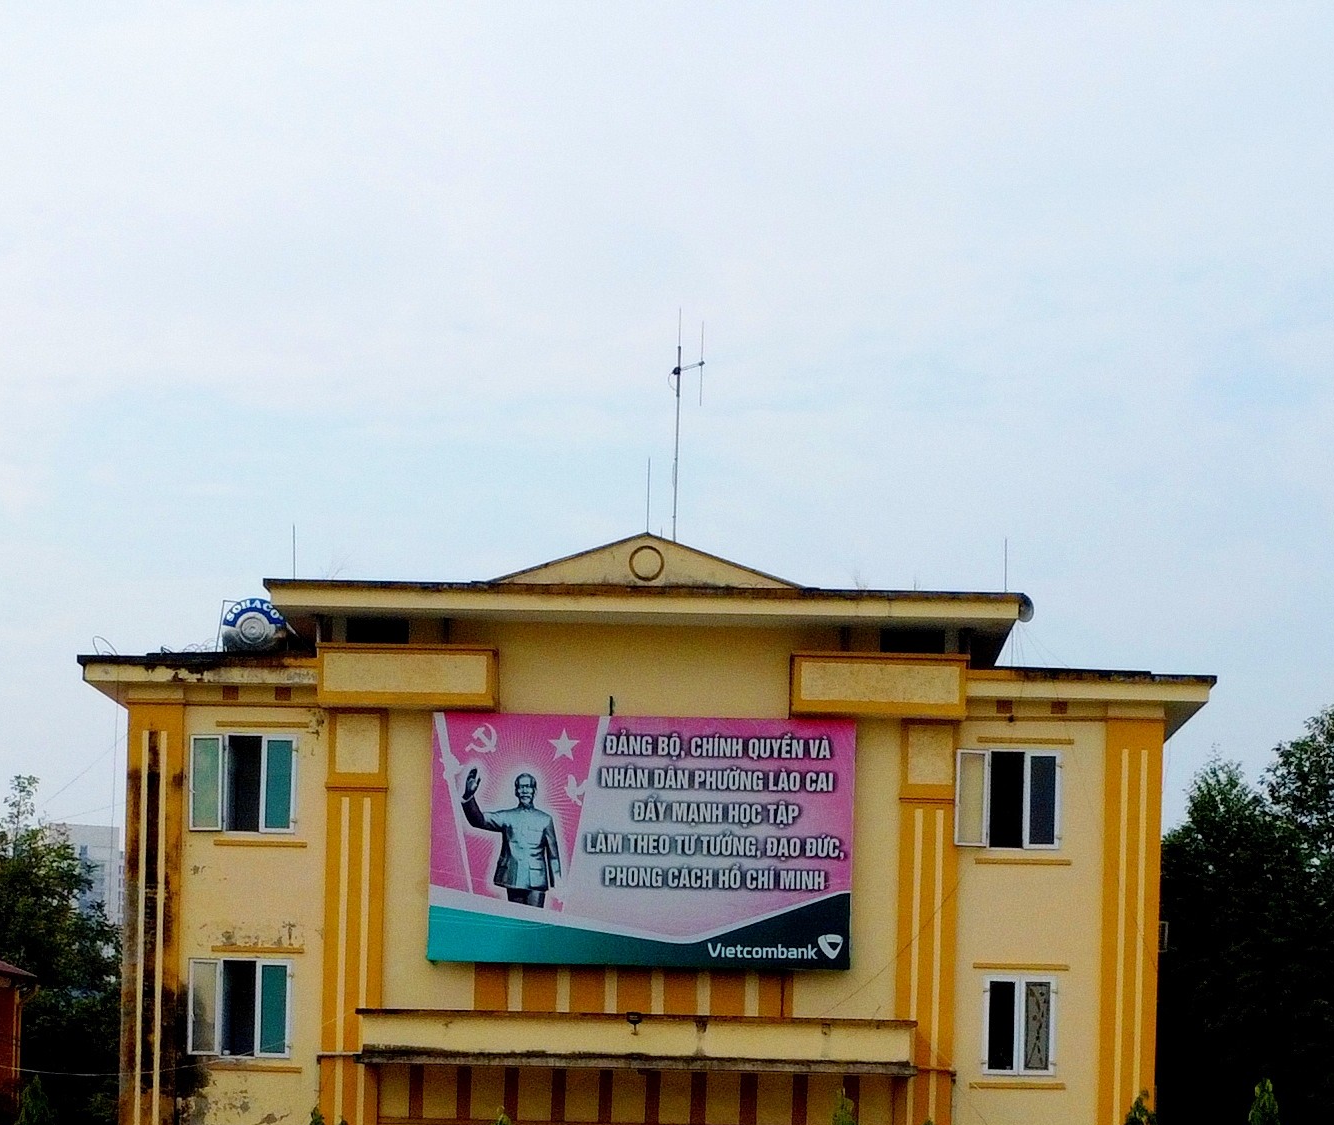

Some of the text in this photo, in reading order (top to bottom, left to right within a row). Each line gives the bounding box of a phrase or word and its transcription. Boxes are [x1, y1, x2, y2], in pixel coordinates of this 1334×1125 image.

[605, 730, 831, 760] ĐẢNG BỘ, CHÍNH QUYỀN VÀ
[601, 764, 833, 792] NHÂN DÂN PHƯỜNG LÀO CAI
[633, 793, 799, 828] ĐẨY MẠNH HỌC TẬP
[586, 830, 844, 861] LÀM THEO TƯ TƯỞNG, ĐẠO ĐỨC,
[604, 861, 825, 890] PHONG CÁCH HỒ CHÍ MINH
[707, 942, 817, 960] Vietcombank
